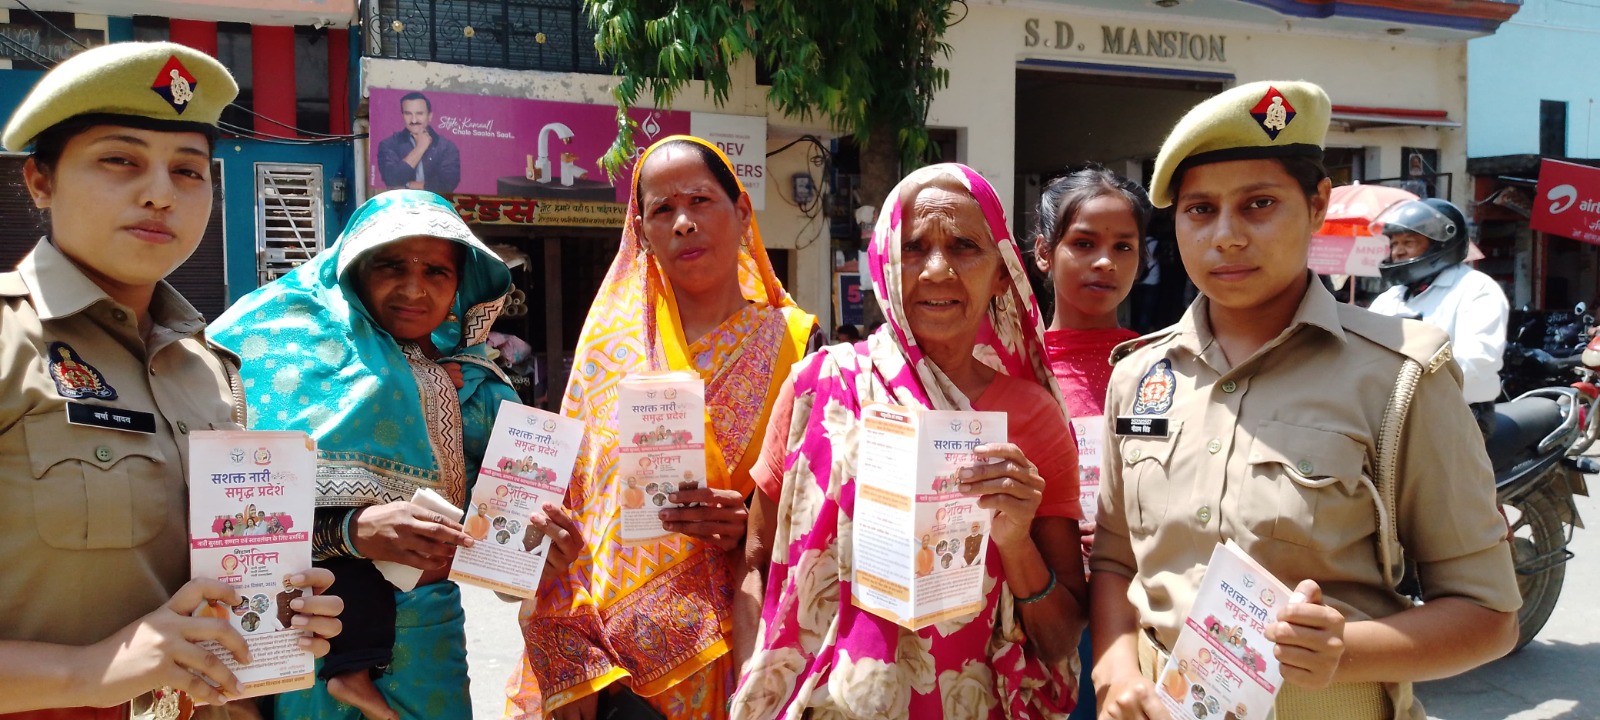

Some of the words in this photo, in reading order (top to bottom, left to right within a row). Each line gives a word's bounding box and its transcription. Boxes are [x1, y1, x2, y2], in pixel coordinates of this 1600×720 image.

[1024, 18, 1085, 51] S.D.
[1101, 25, 1227, 62] MANSION
[452, 128, 472, 136] Chale
[716, 141, 745, 156] DEV
[632, 404, 657, 413] सशक्त
[660, 401, 676, 412] नारी
[112, 414, 131, 424] यादव
[508, 427, 534, 440] सशक्त
[535, 433, 552, 445] नारी
[933, 439, 962, 450] सशक्त
[211, 472, 246, 485] सशक्त
[249, 469, 271, 483] नारी
[225, 486, 255, 502] समृद्ध
[258, 483, 285, 497] प्रदेश
[1220, 580, 1248, 607] सशक्त
[1248, 601, 1268, 622] नारी
[1225, 598, 1251, 624] समृद्ध
